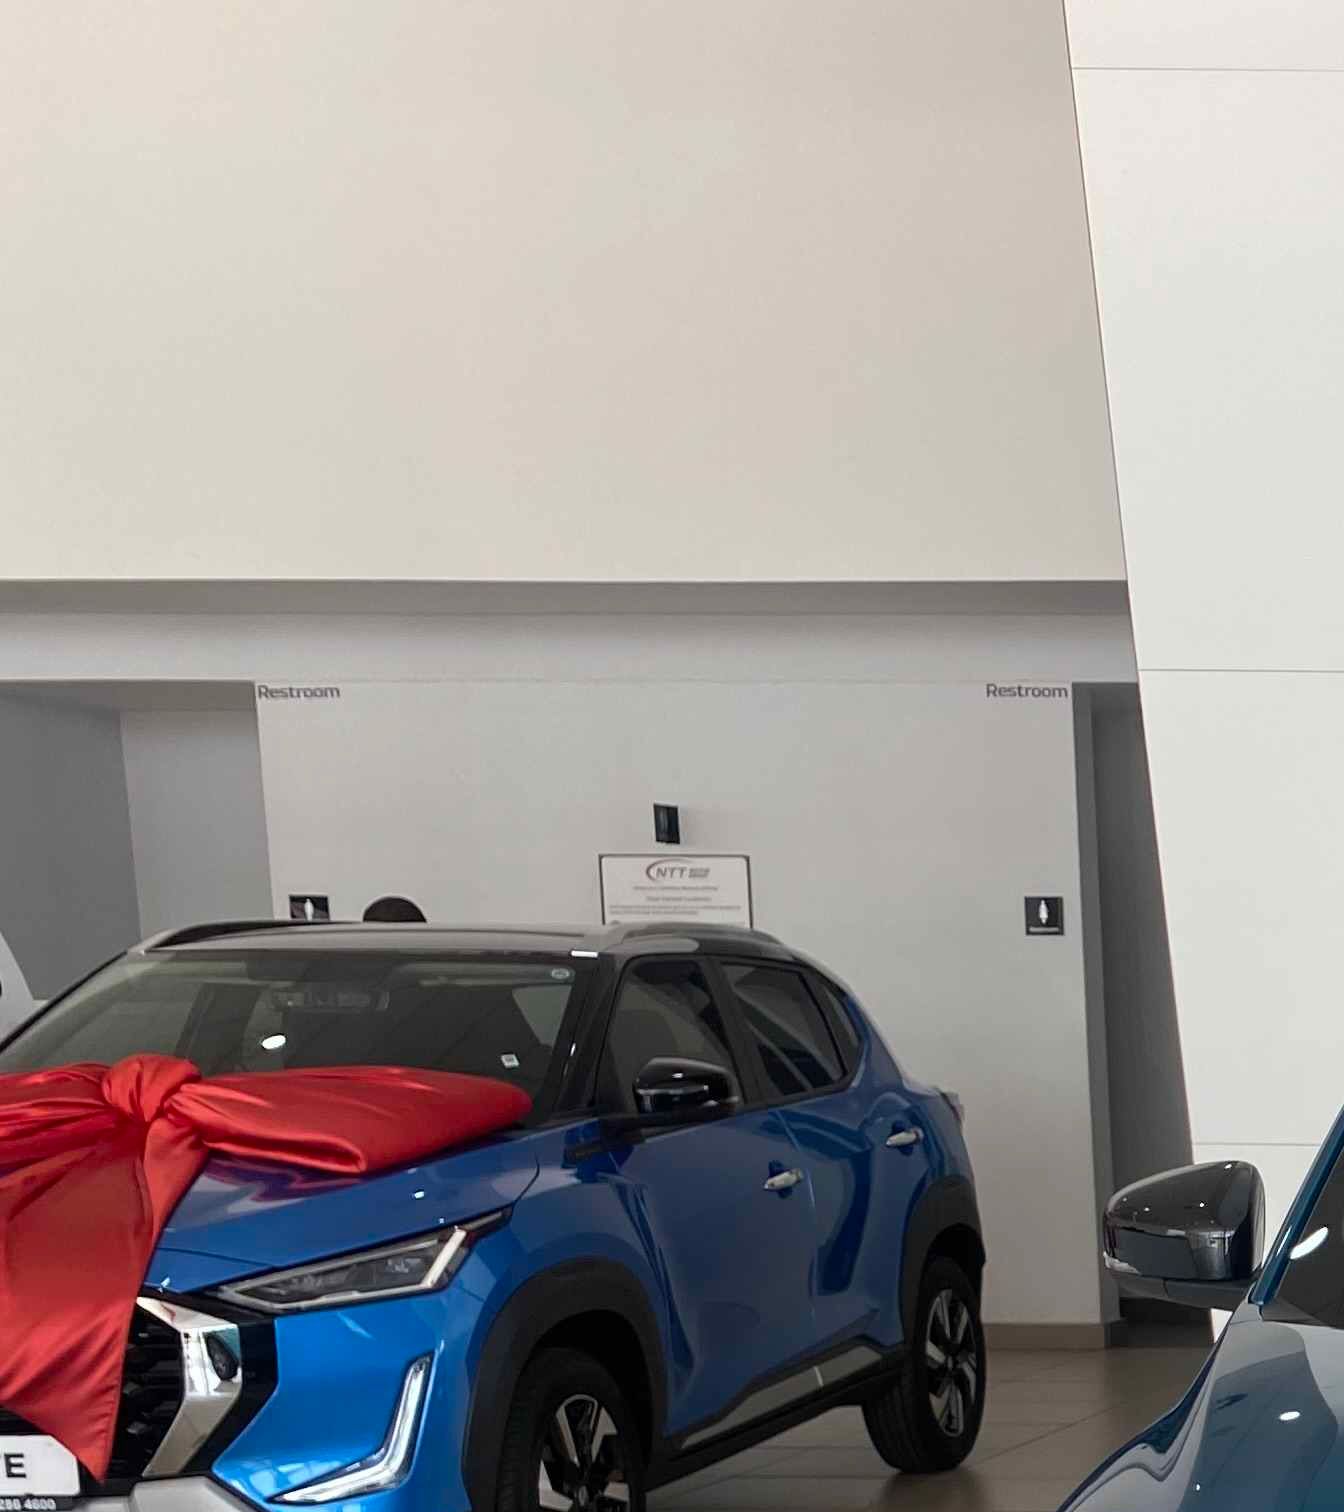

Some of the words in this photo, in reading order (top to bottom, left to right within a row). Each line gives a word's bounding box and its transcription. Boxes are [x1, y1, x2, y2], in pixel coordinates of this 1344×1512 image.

[257, 684, 340, 698] Restroom
[986, 683, 1068, 698] Restroom
[656, 867, 687, 879] NTT
[0, 1453, 26, 1478] E
